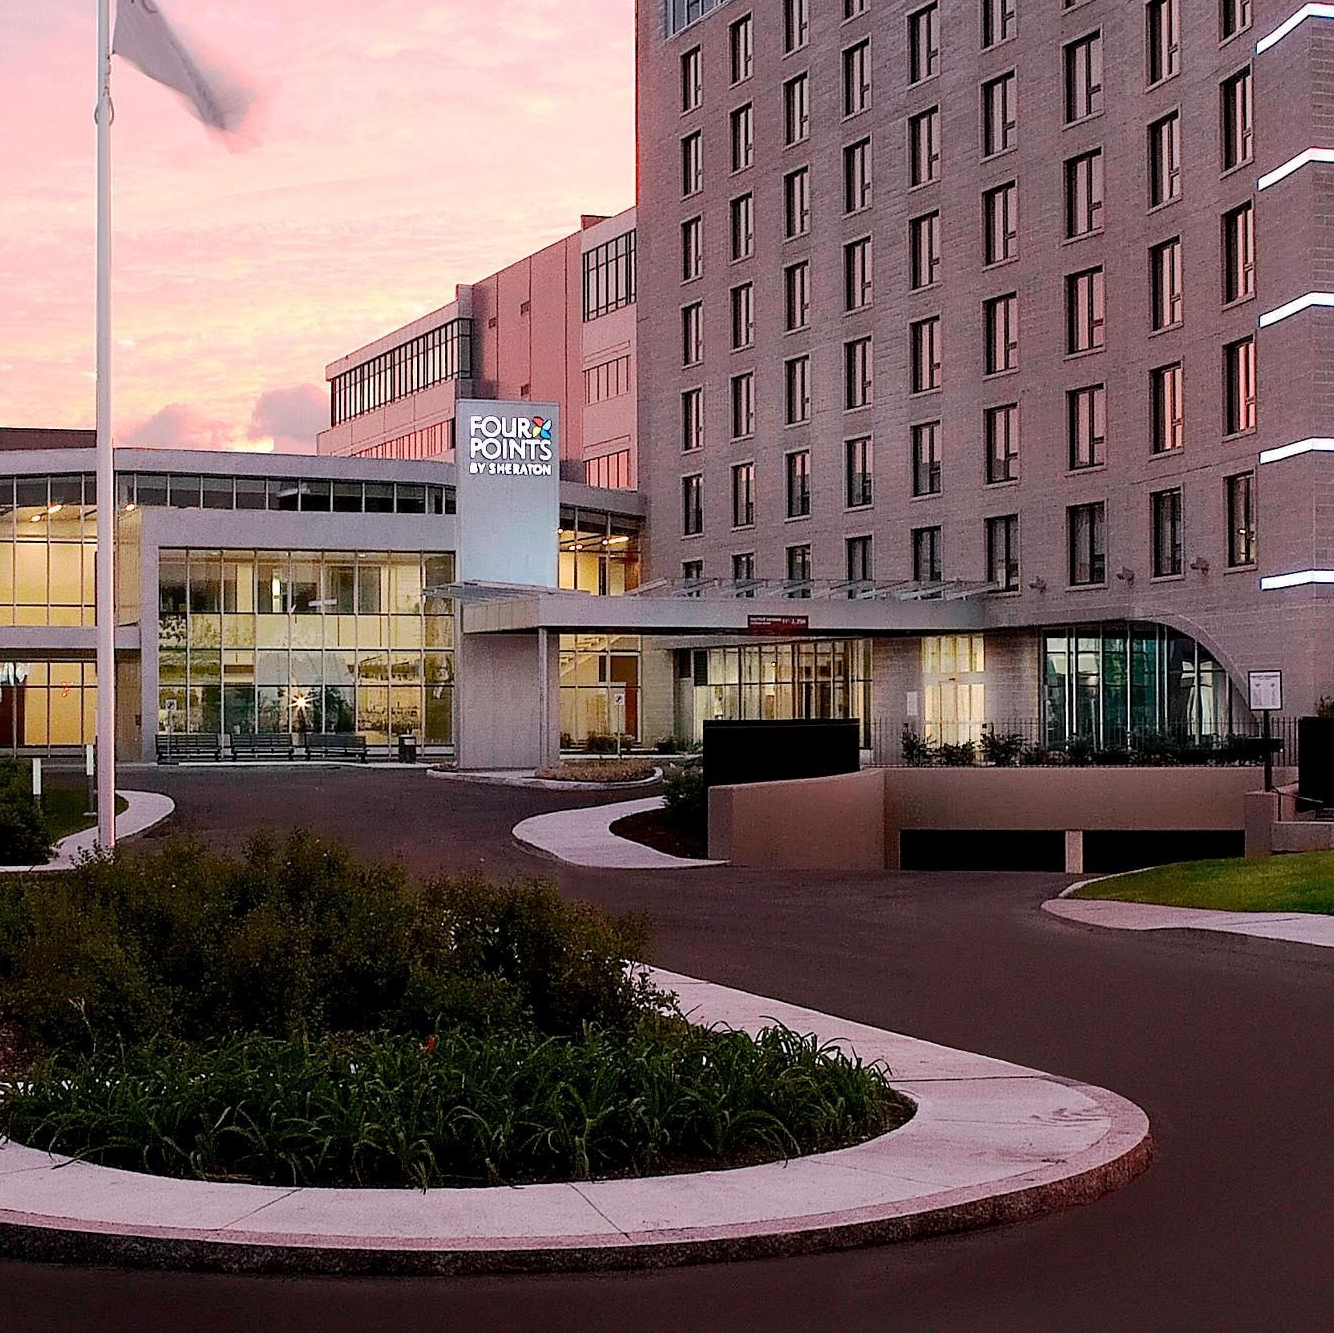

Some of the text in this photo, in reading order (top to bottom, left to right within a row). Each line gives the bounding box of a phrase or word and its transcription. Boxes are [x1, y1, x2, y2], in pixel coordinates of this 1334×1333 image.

[470, 416, 532, 438] FOUR
[470, 437, 552, 460] POINTS
[469, 463, 552, 476] BY SHERATON
